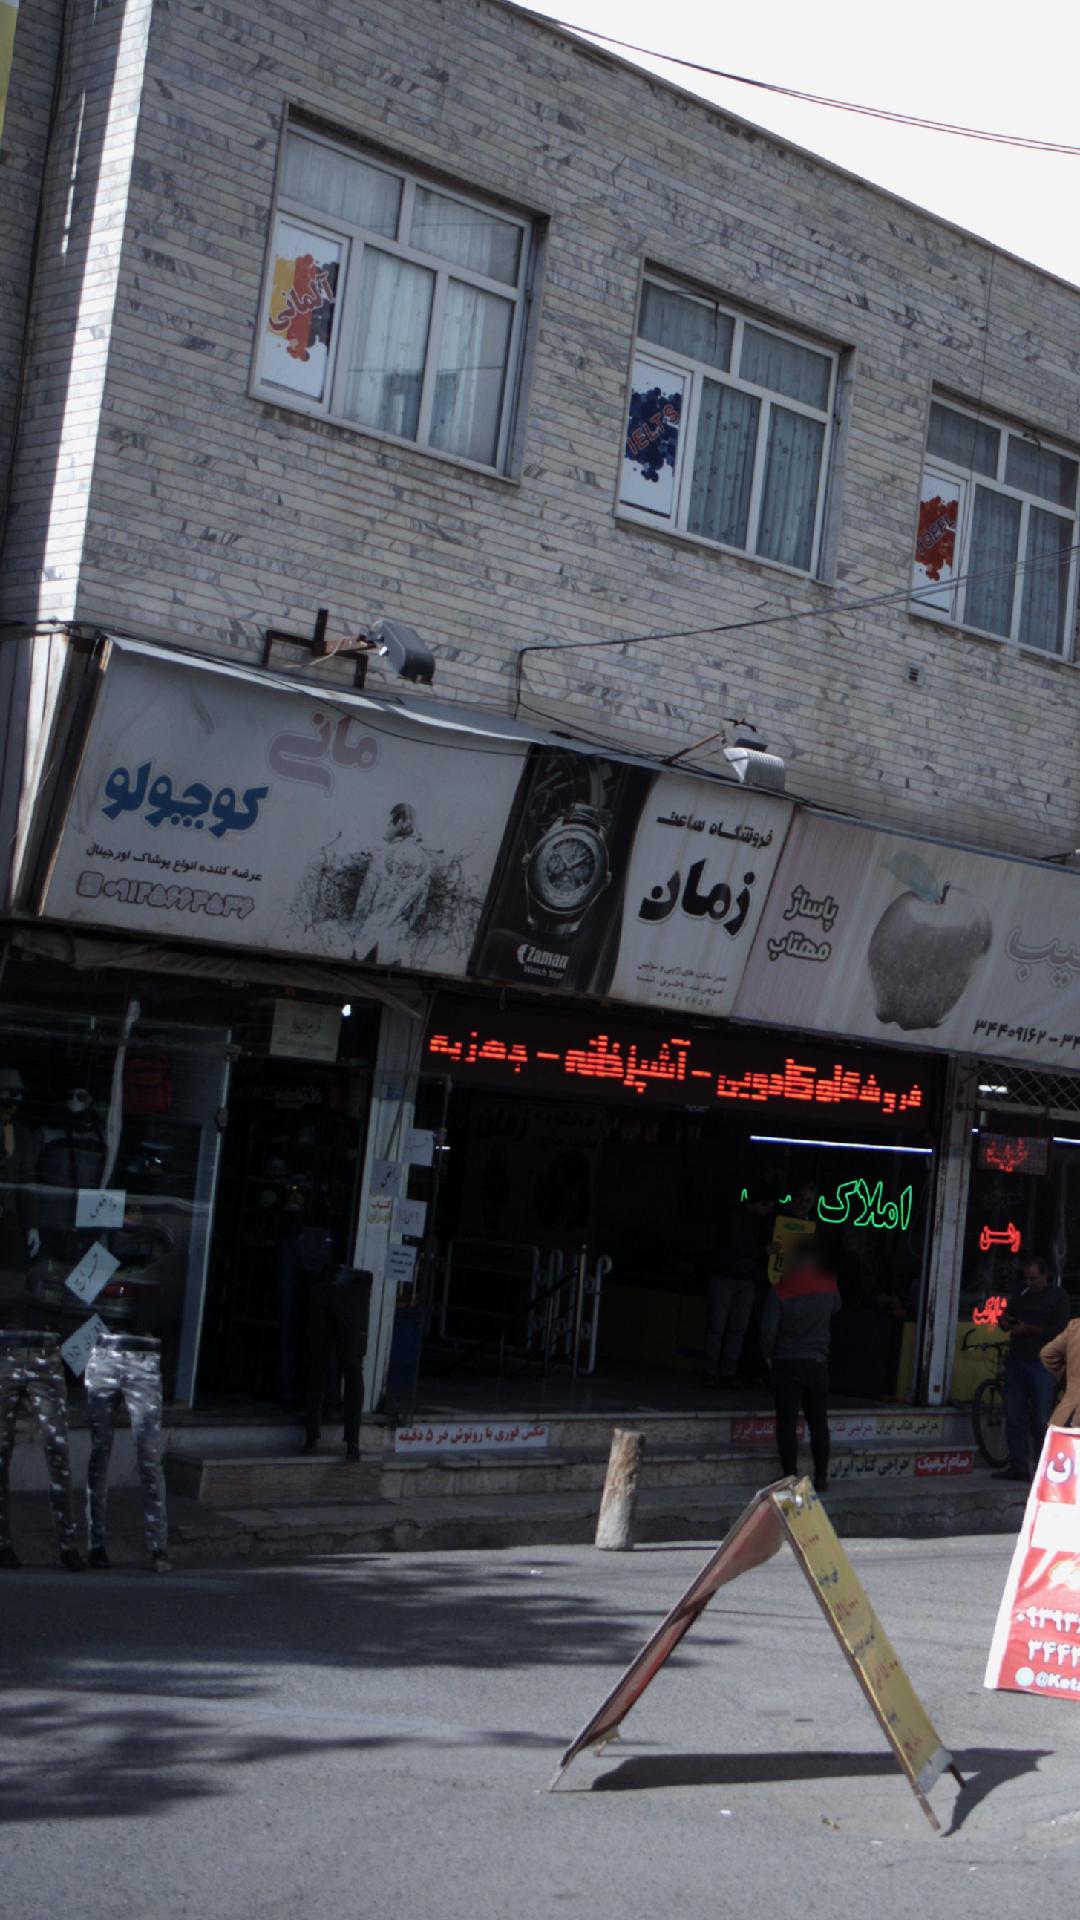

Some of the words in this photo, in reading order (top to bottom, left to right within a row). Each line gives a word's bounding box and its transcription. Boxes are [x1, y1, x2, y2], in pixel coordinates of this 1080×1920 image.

[269, 270, 334, 333] آلمانی
[627, 403, 679, 455] IELTS
[266, 712, 380, 798] مانی
[102, 762, 269, 839] کوچولو
[655, 810, 706, 833] ساعت
[708, 822, 774, 849] فروشگاه
[133, 852, 172, 870] پوشاک
[172, 859, 198, 873] انواع
[199, 863, 231, 876] کننده
[232, 868, 262, 882] عرضه
[638, 858, 756, 937] زمان
[782, 884, 839, 932] پاساژ
[767, 930, 832, 962] مهتاب
[526, 946, 570, 970] Zaman
[817, 1178, 913, 1231] املاک
[398, 1427, 424, 1444] دقیقه
[425, 1427, 433, 1442] ۵
[436, 1430, 449, 1444] در
[485, 1426, 494, 1442] با
[494, 1426, 520, 1442] فوری
[521, 1424, 545, 1441] عکس
[830, 1458, 855, 1478] ایران
[855, 1456, 877, 1473] کتاب
[877, 1457, 909, 1476] حراجی
